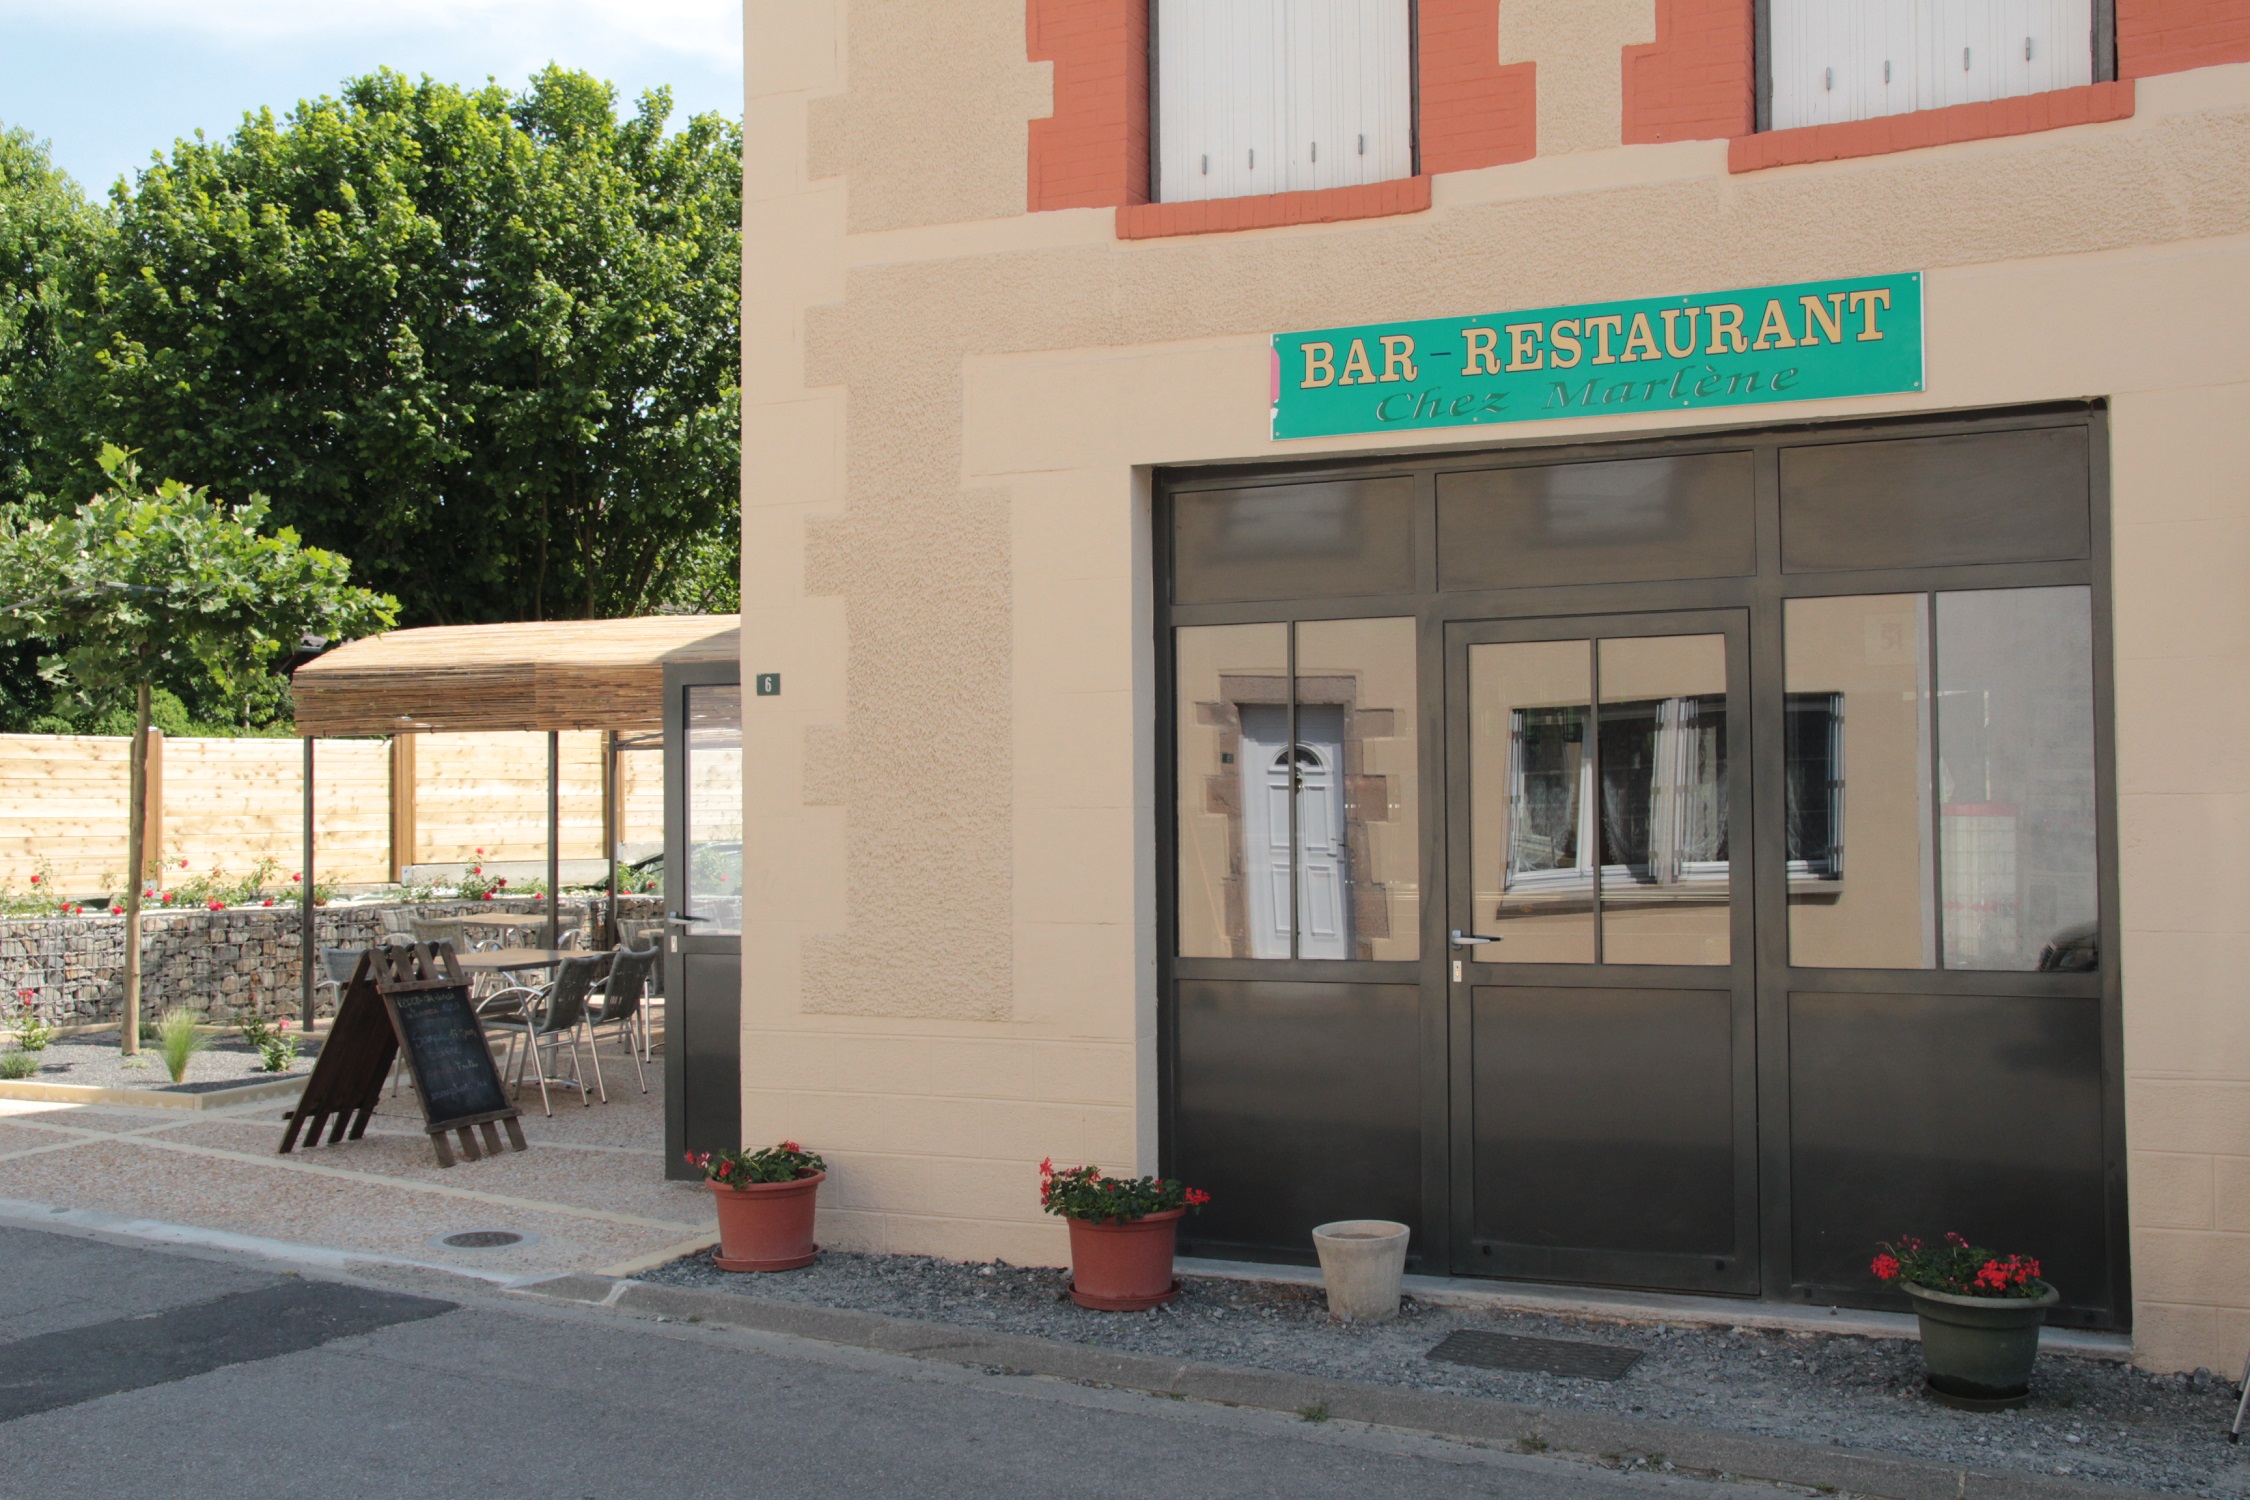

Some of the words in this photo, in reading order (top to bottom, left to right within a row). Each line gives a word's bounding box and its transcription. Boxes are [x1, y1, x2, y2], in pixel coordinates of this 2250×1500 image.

[1300, 334, 1418, 389] BAR
[1460, 288, 1891, 376] RESTAURANT
[1376, 386, 1510, 422] Chez
[1540, 365, 1799, 410] Marlène
[764, 676, 772, 693] 6
